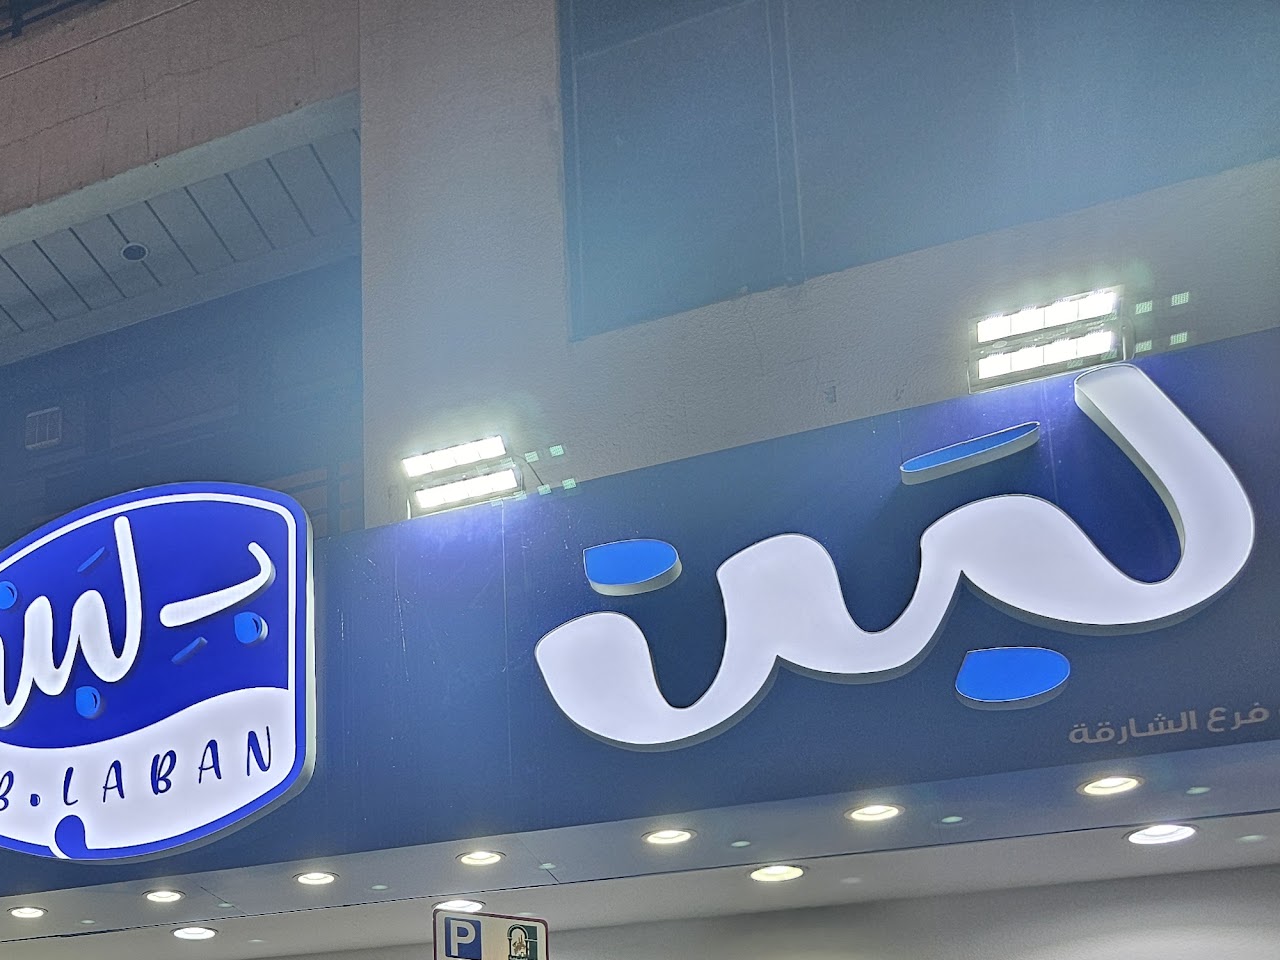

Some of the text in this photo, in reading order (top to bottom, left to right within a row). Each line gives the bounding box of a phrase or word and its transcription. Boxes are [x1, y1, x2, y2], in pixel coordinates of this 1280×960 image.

[1068, 702, 1270, 745] فرع الشارقة
[450, 919, 476, 957] P
